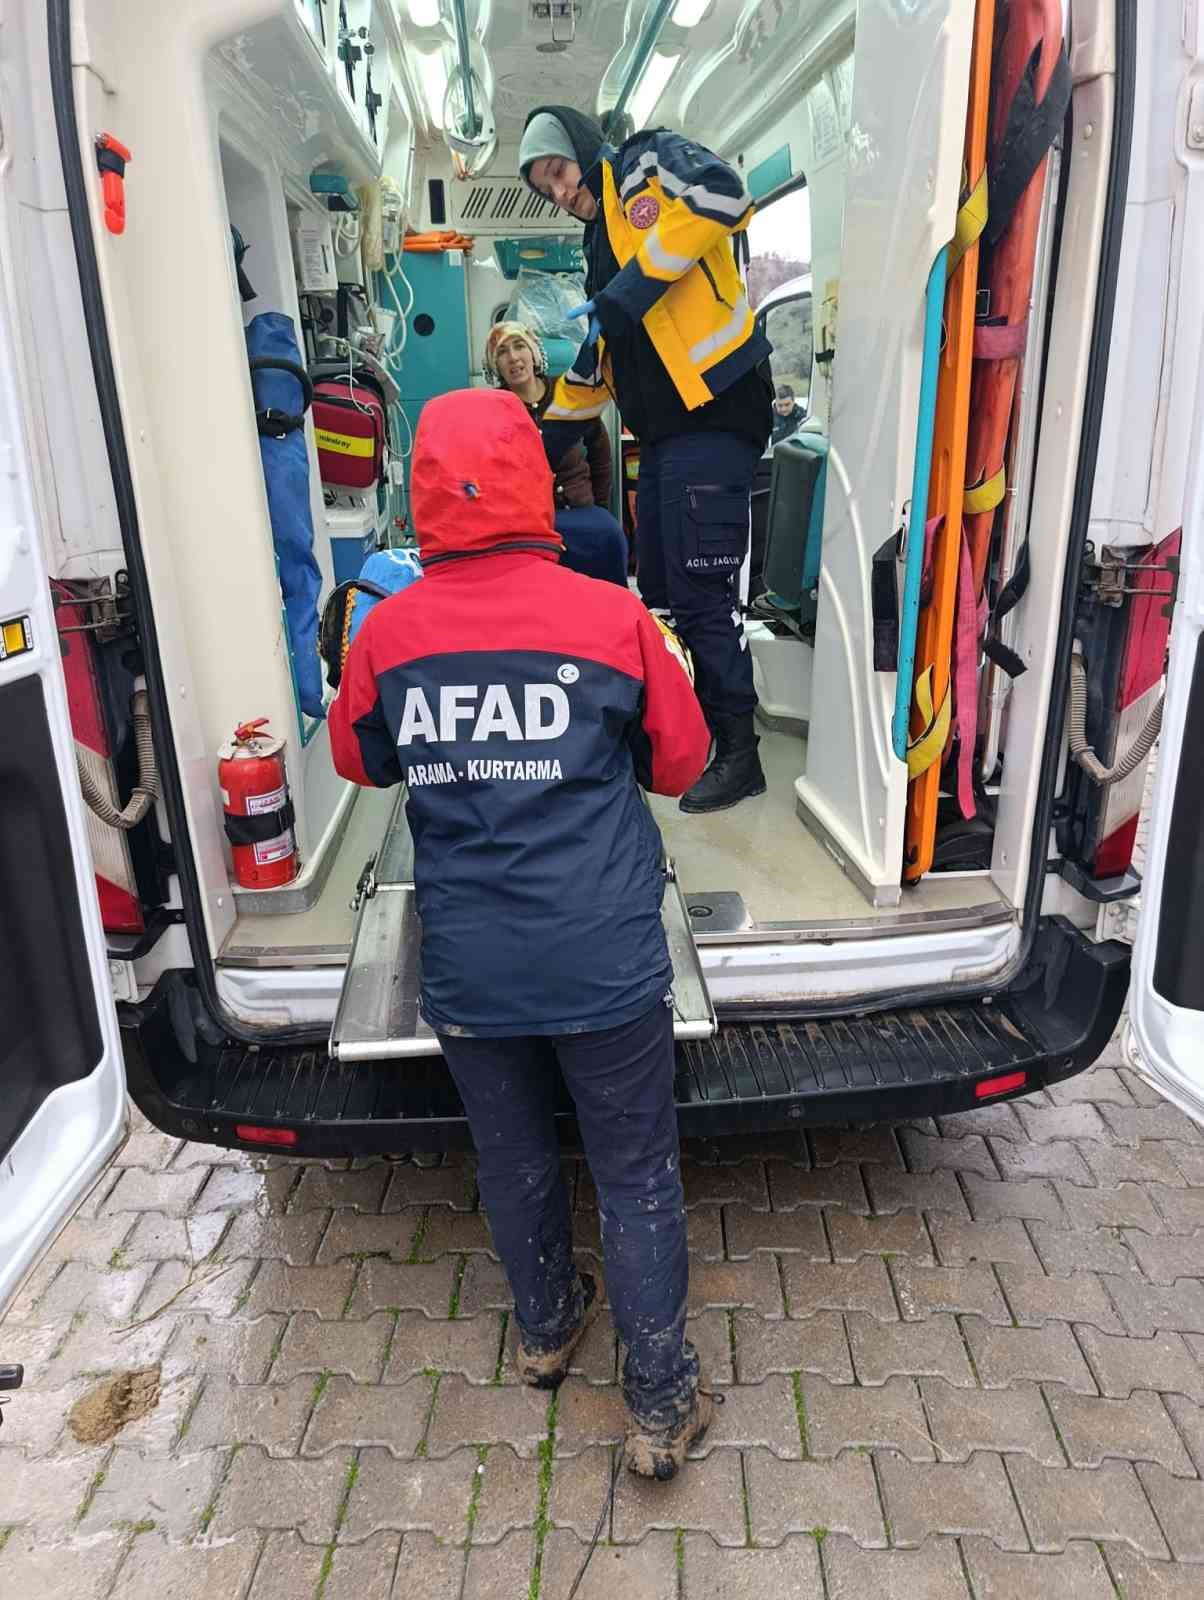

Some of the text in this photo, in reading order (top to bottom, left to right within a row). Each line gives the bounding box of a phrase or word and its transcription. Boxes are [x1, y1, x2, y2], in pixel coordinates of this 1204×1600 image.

[397, 683, 570, 746] AFAD
[408, 762, 458, 787] ARAMA
[467, 759, 563, 781] KURTARMA
